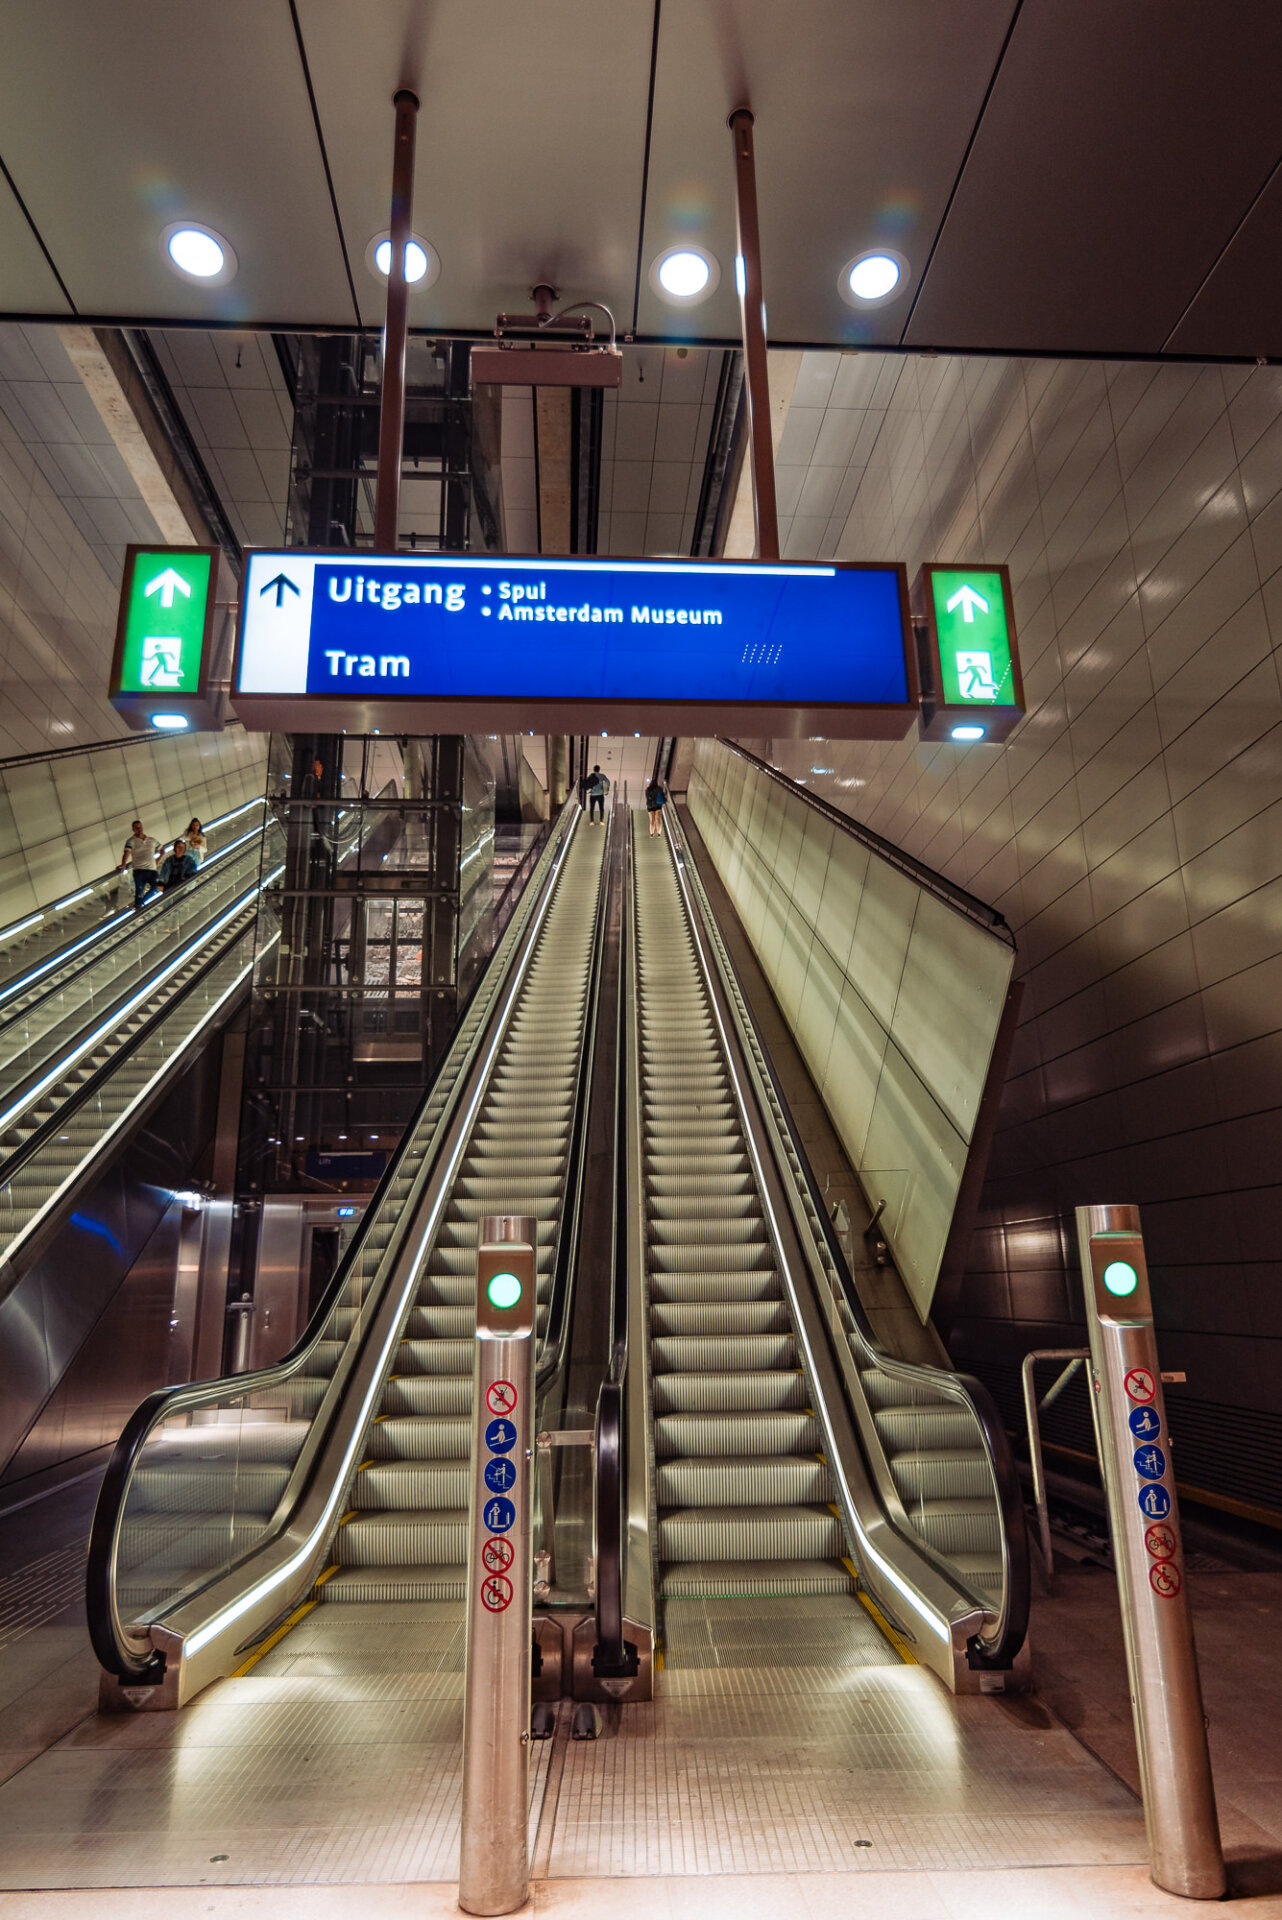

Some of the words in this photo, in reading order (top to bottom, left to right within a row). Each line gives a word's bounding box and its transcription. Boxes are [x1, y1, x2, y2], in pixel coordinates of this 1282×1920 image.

[329, 577, 466, 612] Uitgang
[499, 582, 546, 601] Spui
[499, 602, 624, 623] Amsterdam
[631, 606, 723, 625] Museum
[325, 650, 410, 677] Tram
